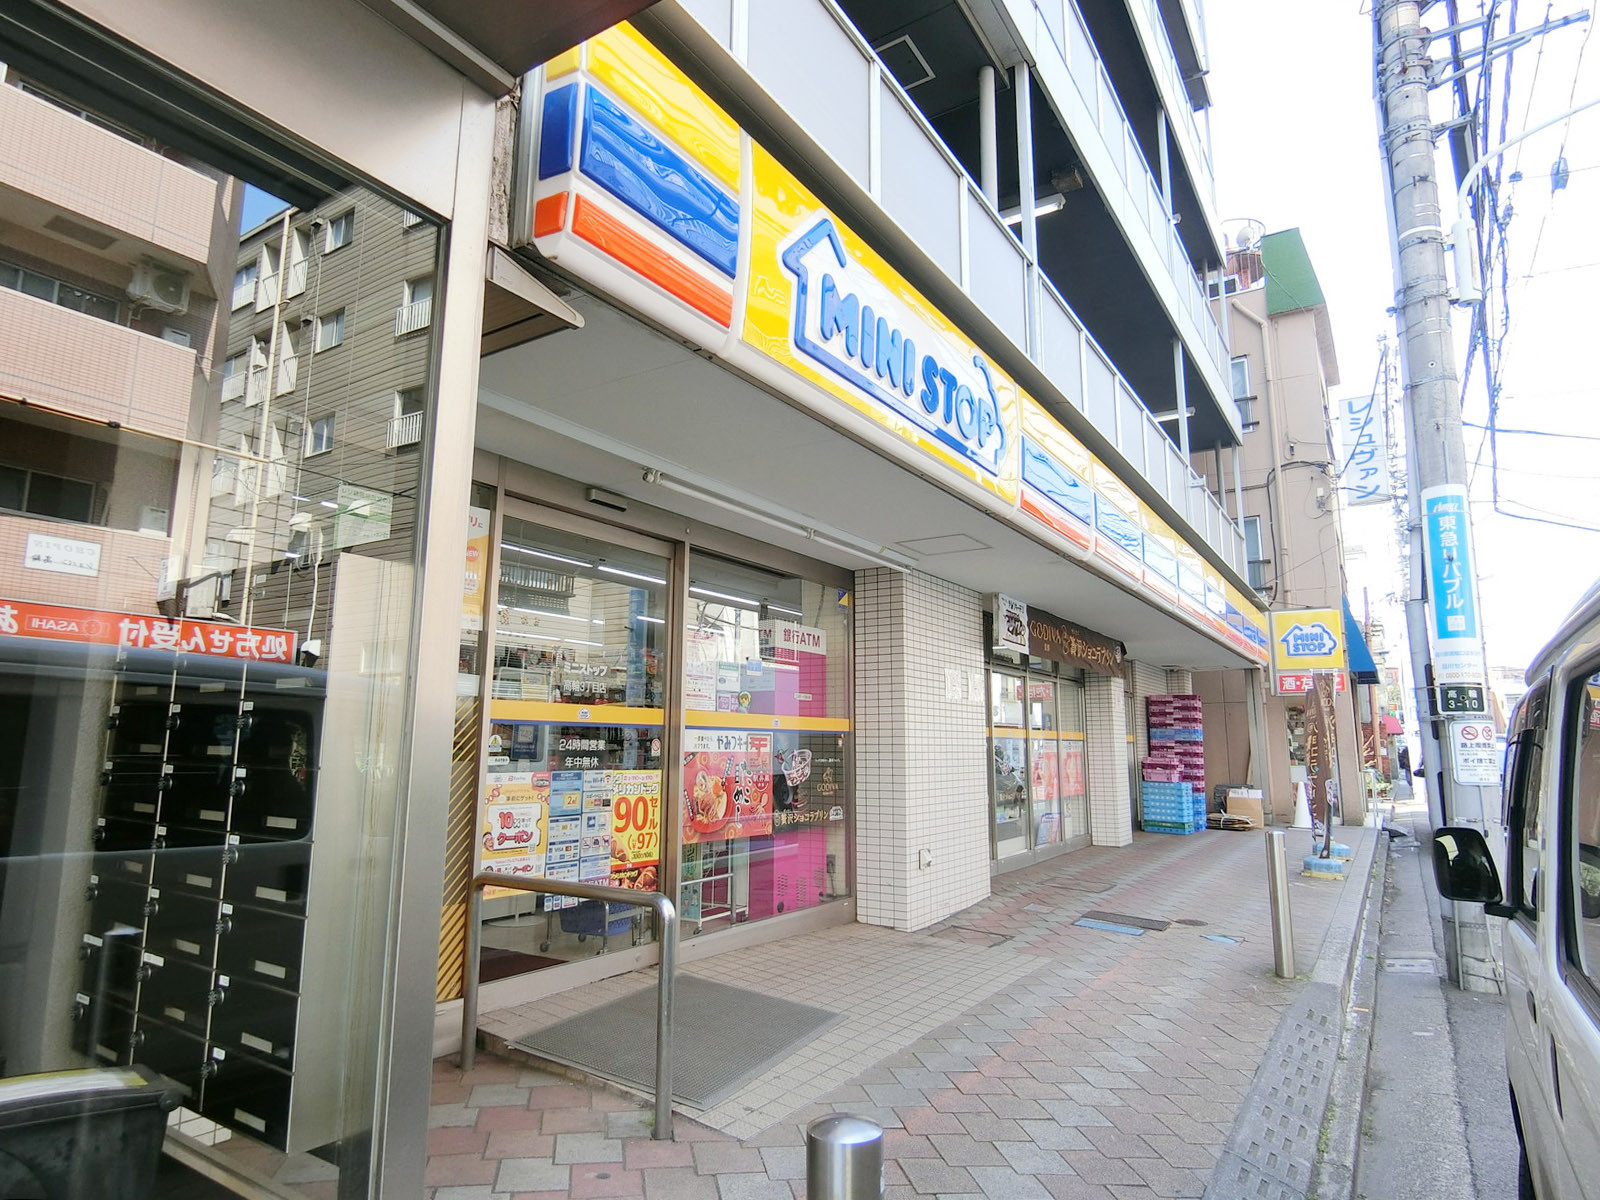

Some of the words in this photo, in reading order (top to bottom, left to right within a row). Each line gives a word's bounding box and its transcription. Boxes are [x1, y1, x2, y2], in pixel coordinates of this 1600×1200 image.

[820, 273, 916, 398] MINI
[920, 354, 996, 450] STOP
[1438, 515, 1464, 610] 東急リバブル
[783, 627, 821, 648] 銀行ATM
[1029, 619, 1061, 645] GODIVA
[1293, 632, 1324, 642] MINI
[1293, 642, 1326, 653] STOP
[563, 662, 608, 677] ミニストップ
[563, 680, 607, 695] 高輪3丁目店
[1448, 700, 1478, 709] 3-10
[559, 738, 607, 752] 24時間営業
[564, 756, 600, 769] 年中無休
[614, 796, 649, 833] 90
[648, 796, 658, 830] セール
